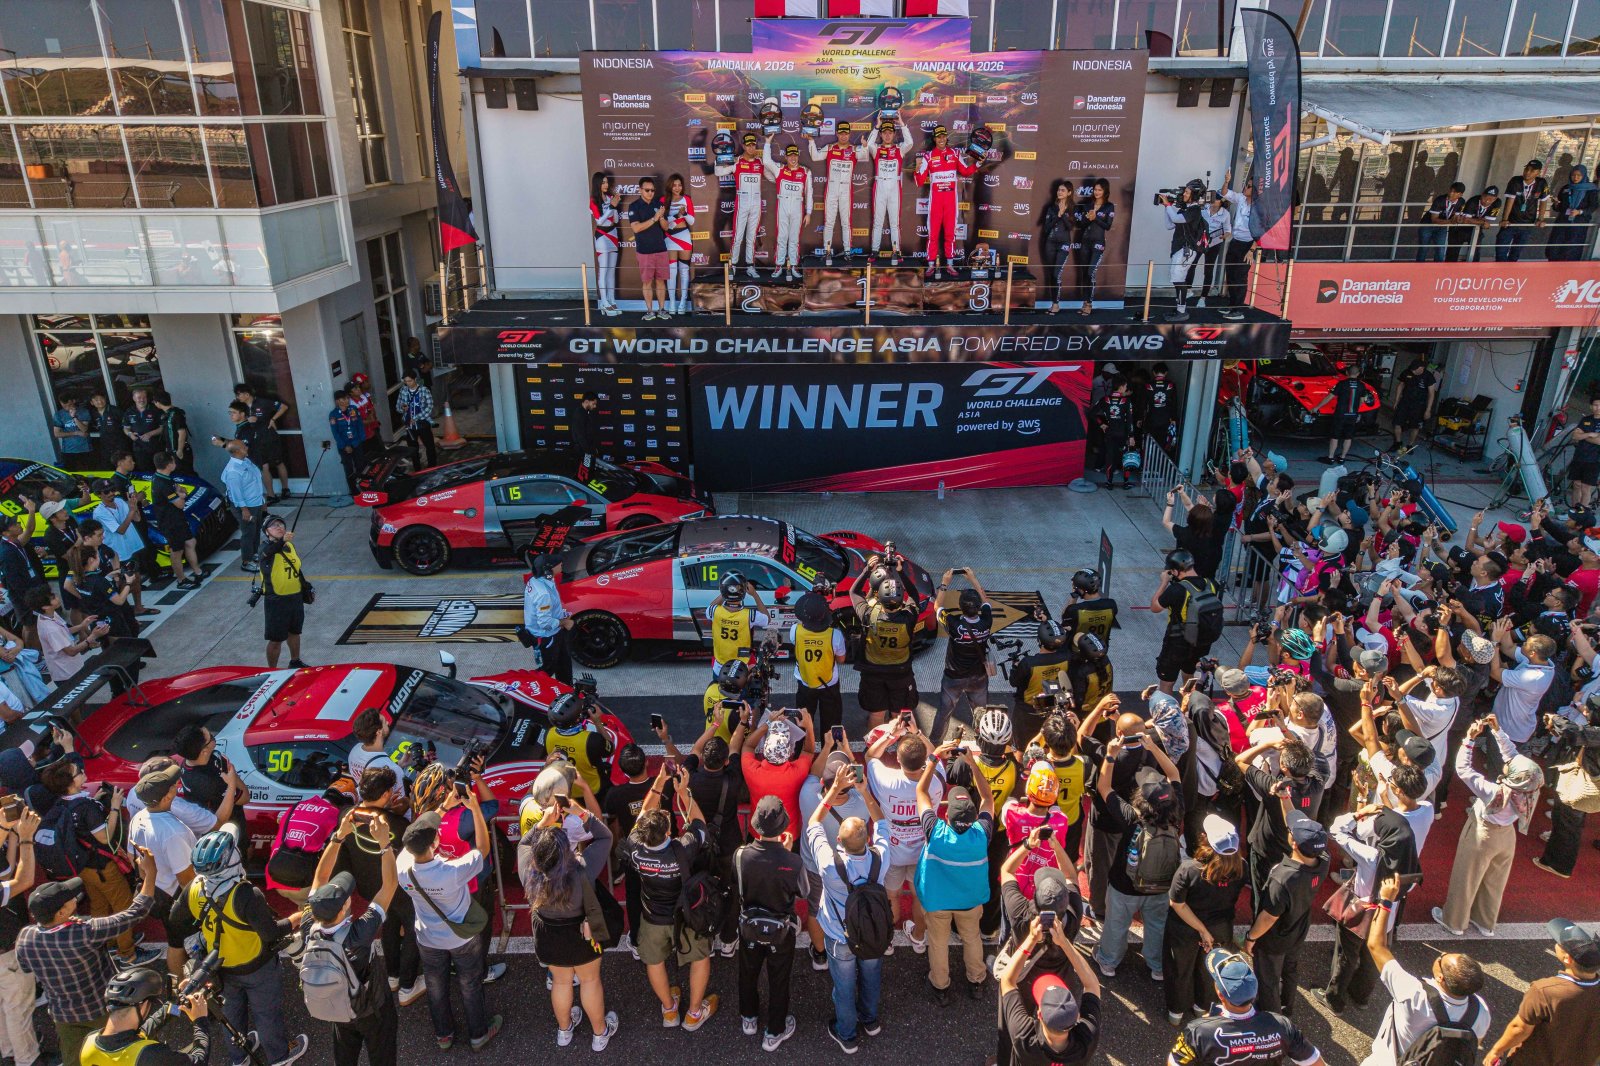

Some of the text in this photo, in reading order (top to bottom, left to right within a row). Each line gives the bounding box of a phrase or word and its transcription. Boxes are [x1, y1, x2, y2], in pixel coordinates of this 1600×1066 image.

[818, 22, 908, 45] GT
[593, 58, 654, 71] INDONESIA
[707, 61, 795, 73] MANDALIKA 2026
[912, 61, 1005, 73] MANDALIKA 2026
[1072, 60, 1133, 71] INDONESIA
[815, 67, 849, 77] powered
[850, 66, 860, 77] by
[613, 93, 652, 102] Danantara
[748, 92, 765, 100] aws
[1021, 92, 1038, 100] aws
[1087, 94, 1126, 103] Danantara
[613, 101, 650, 109] Indonesia
[1086, 103, 1123, 111] Indonesia
[602, 121, 650, 134] injourney
[782, 119, 799, 128] aws
[921, 119, 938, 128] aws
[1072, 123, 1121, 135] injourney
[690, 175, 705, 183] aws
[984, 174, 1000, 182] aws
[1013, 203, 1030, 211] aws
[1342, 279, 1411, 291] Danantara
[1435, 277, 1528, 296] injourney
[855, 279, 876, 306] 1
[969, 284, 990, 312] 3
[1339, 292, 1403, 304] Indonesia
[741, 285, 761, 313] 2
[497, 331, 547, 343] GT
[1186, 327, 1235, 341] GT
[569, 335, 1165, 354] GT WORLD CHALLENGE ASIA POWERED BY AWS
[497, 352, 517, 361] powered
[960, 365, 1082, 397] GT
[704, 381, 945, 430] WINNER
[966, 397, 1063, 410] WORLD CHALLENGE
[957, 411, 981, 419] ASIA
[956, 419, 1041, 434] powered by aws
[587, 479, 608, 495] 15
[508, 486, 522, 501] 15
[702, 566, 718, 584] 16
[720, 619, 740, 627] SRO
[1088, 615, 1106, 623] SRO
[720, 627, 739, 642] 53
[879, 636, 898, 649] 78
[804, 649, 823, 663] 09
[1042, 667, 1061, 677] SRO
[51, 673, 101, 709] PERTAMIN
[389, 669, 424, 714] WORLD
[1243, 701, 1267, 719] VENT
[511, 719, 531, 748] Fastron
[267, 750, 293, 773] 50
[509, 779, 537, 793] Telkom
[294, 803, 329, 815] EVENT
[891, 804, 916, 816] JDM
[289, 830, 303, 840] 031
[1021, 825, 1058, 835] EVT
[1229, 1032, 1282, 1046] MANDALIKA
